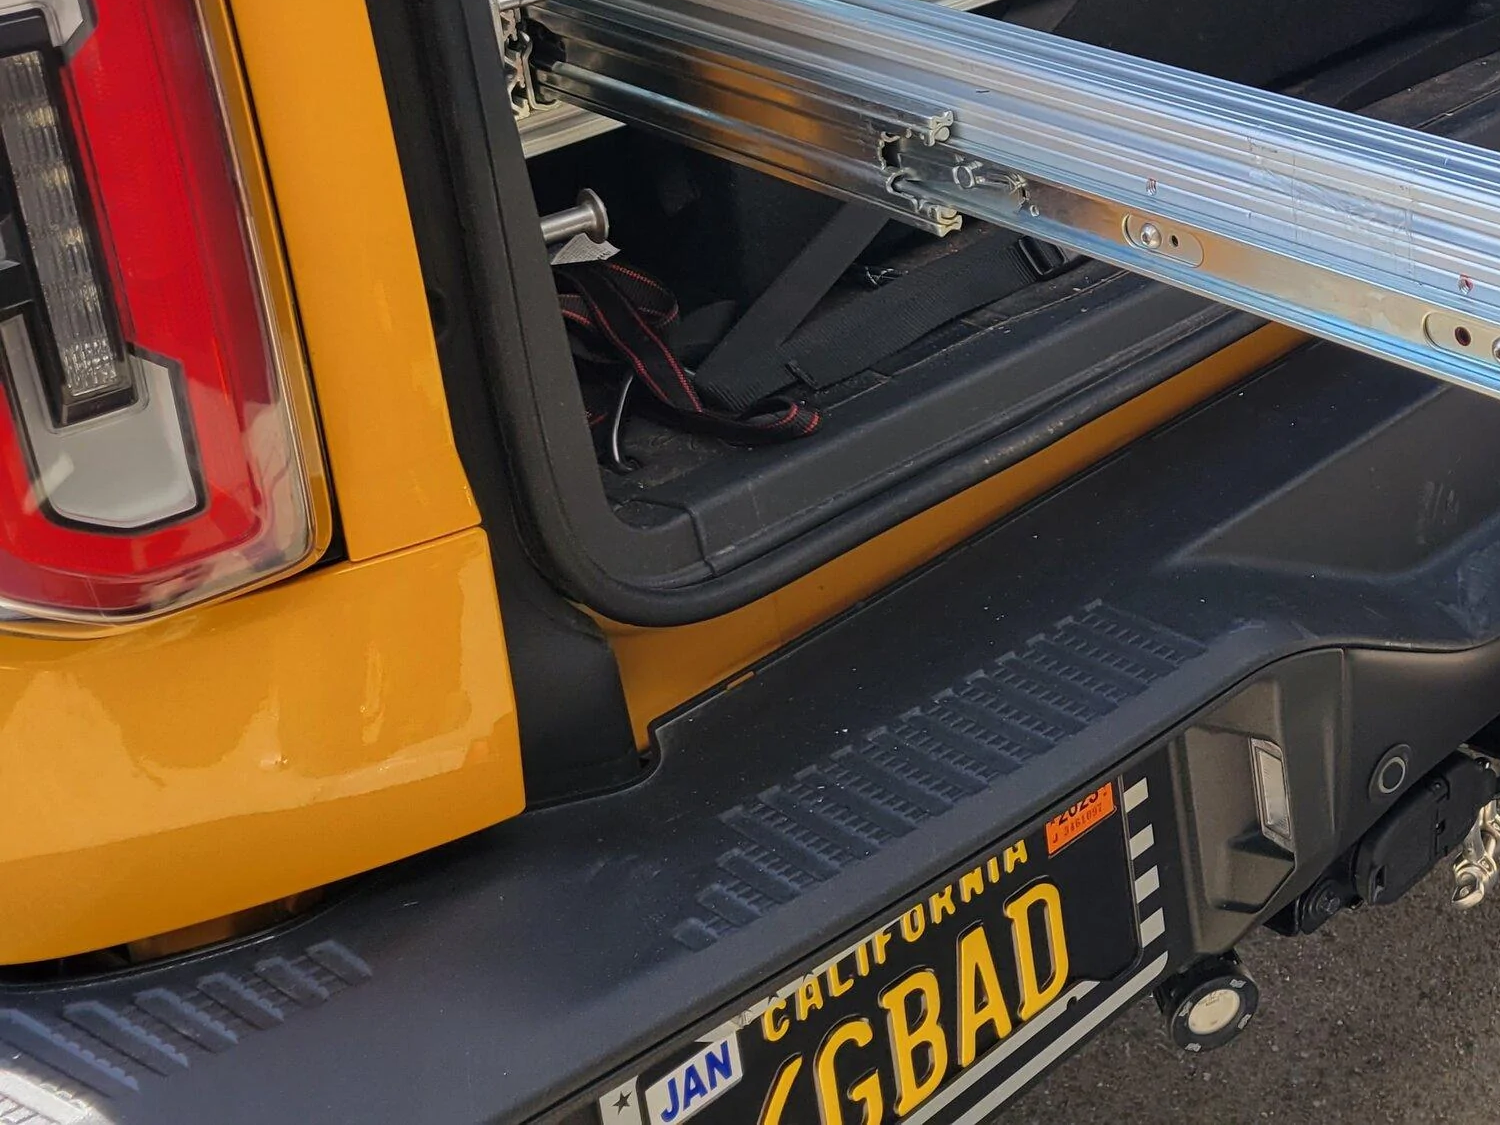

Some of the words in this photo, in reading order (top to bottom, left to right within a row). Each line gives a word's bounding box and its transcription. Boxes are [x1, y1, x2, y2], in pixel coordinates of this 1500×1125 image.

[757, 876, 1069, 1125] GBAD
[761, 839, 1028, 1042] CALIFORNIA
[660, 1040, 733, 1123] JAN
